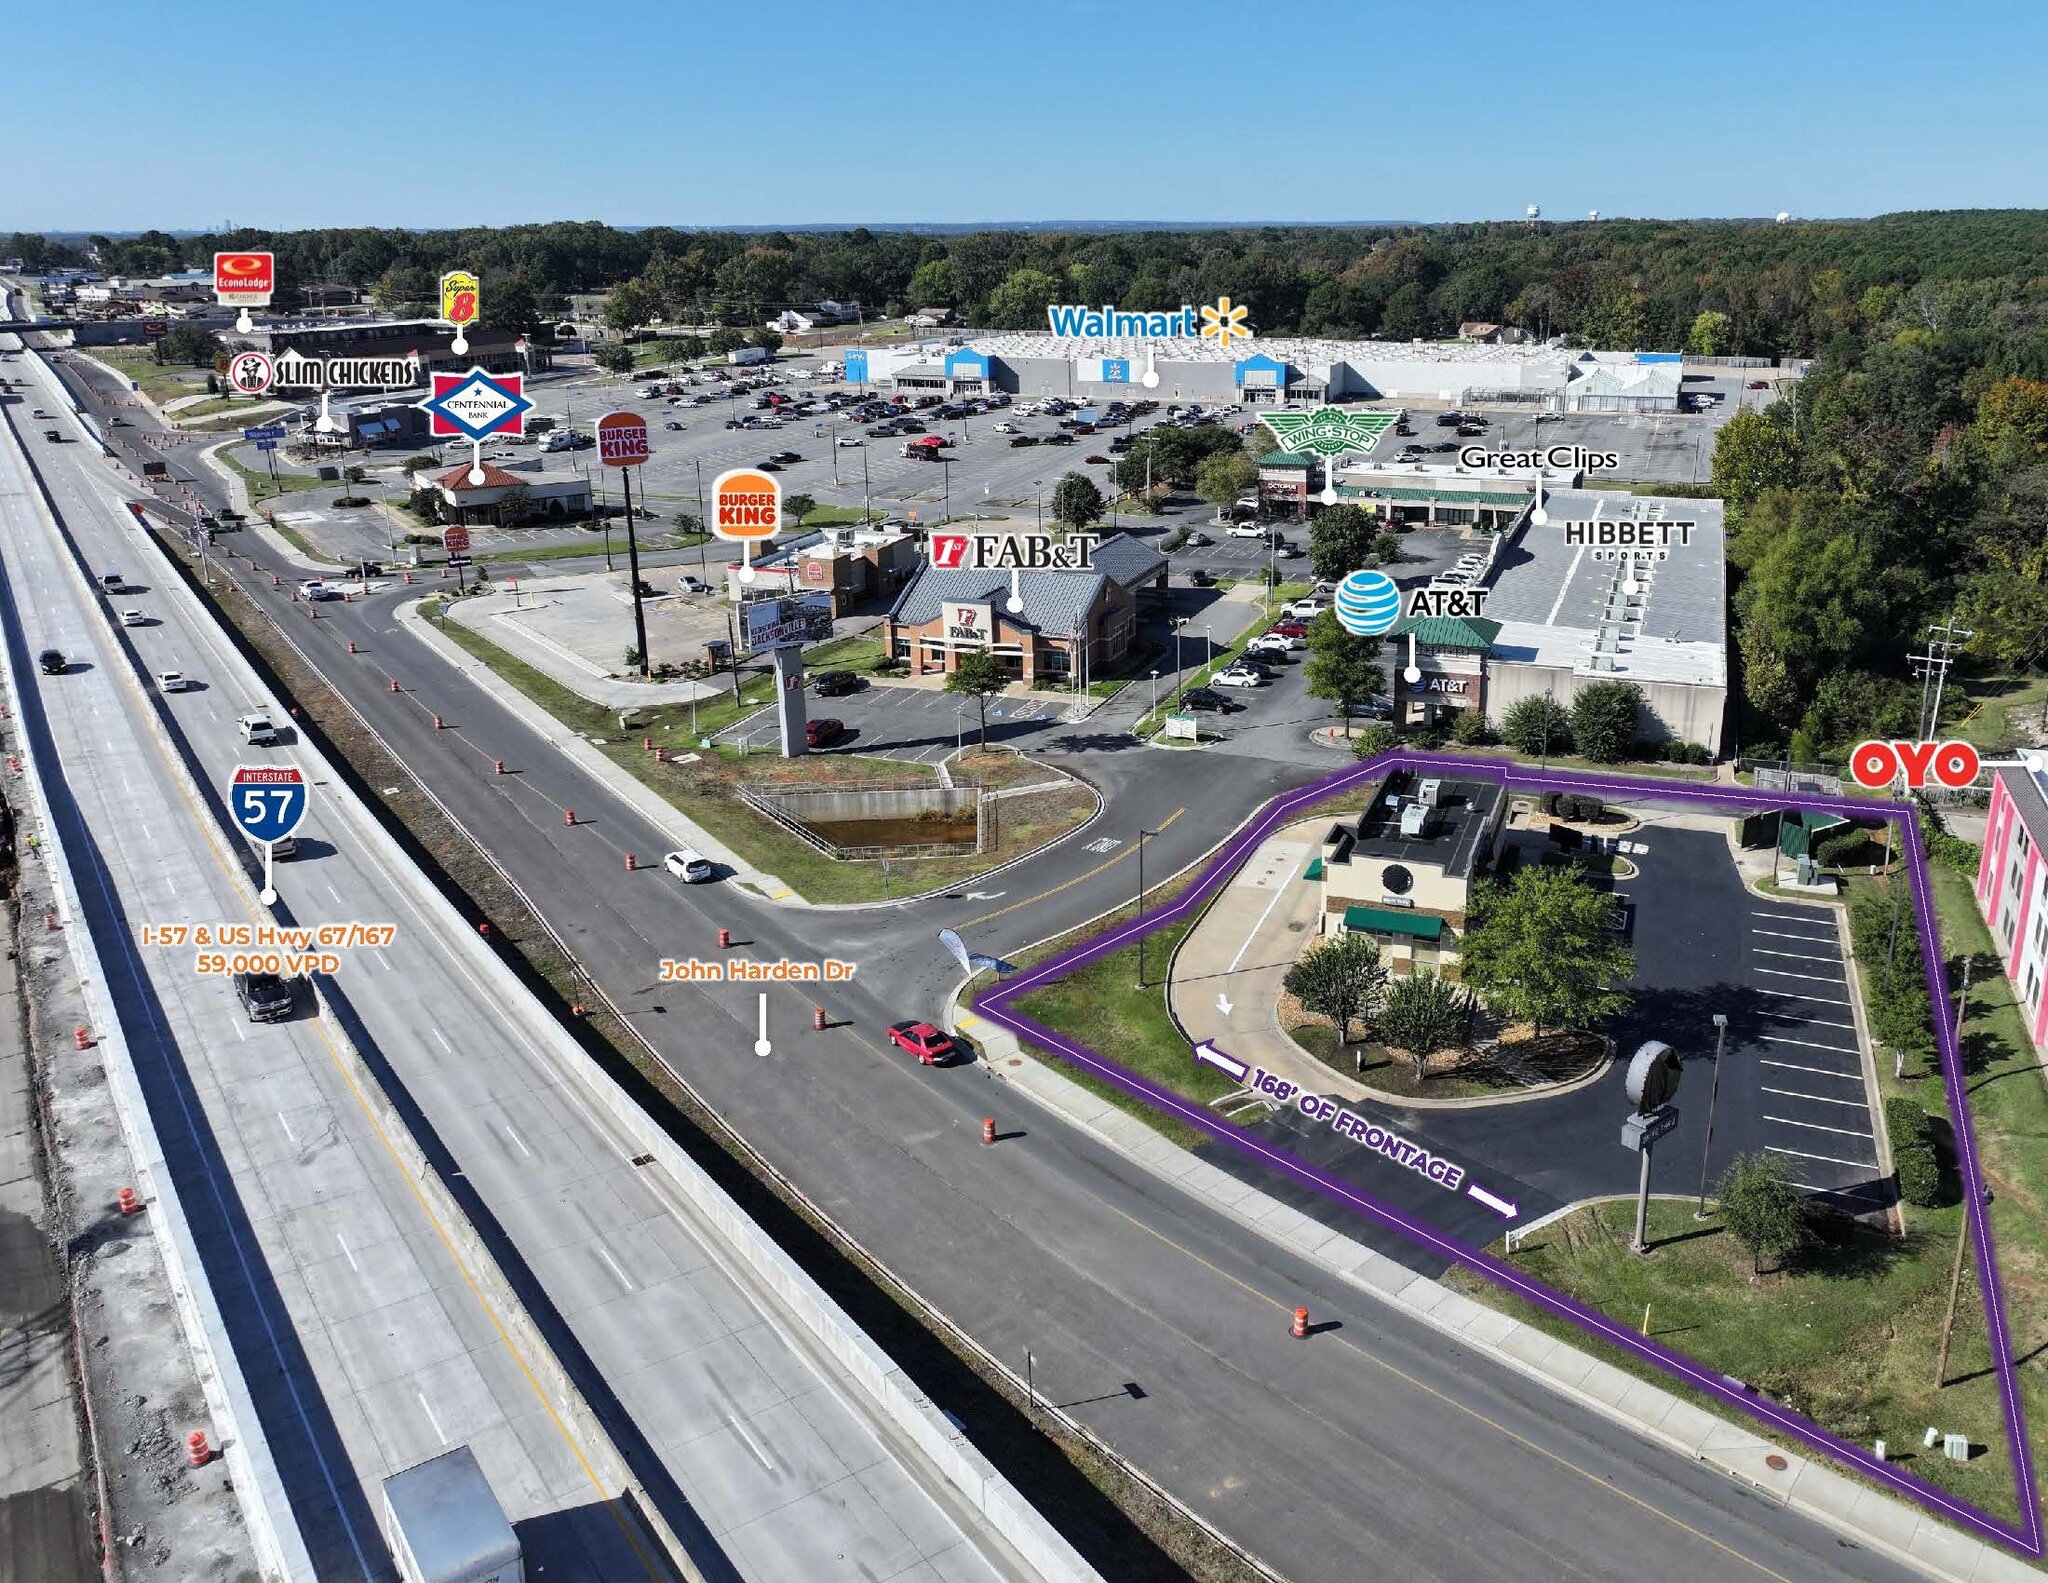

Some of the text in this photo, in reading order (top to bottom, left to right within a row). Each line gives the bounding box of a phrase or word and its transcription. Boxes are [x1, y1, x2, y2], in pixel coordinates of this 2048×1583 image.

[599, 428, 648, 441] BURGER
[600, 439, 649, 457] KING
[1430, 679, 1467, 693] AT&T
